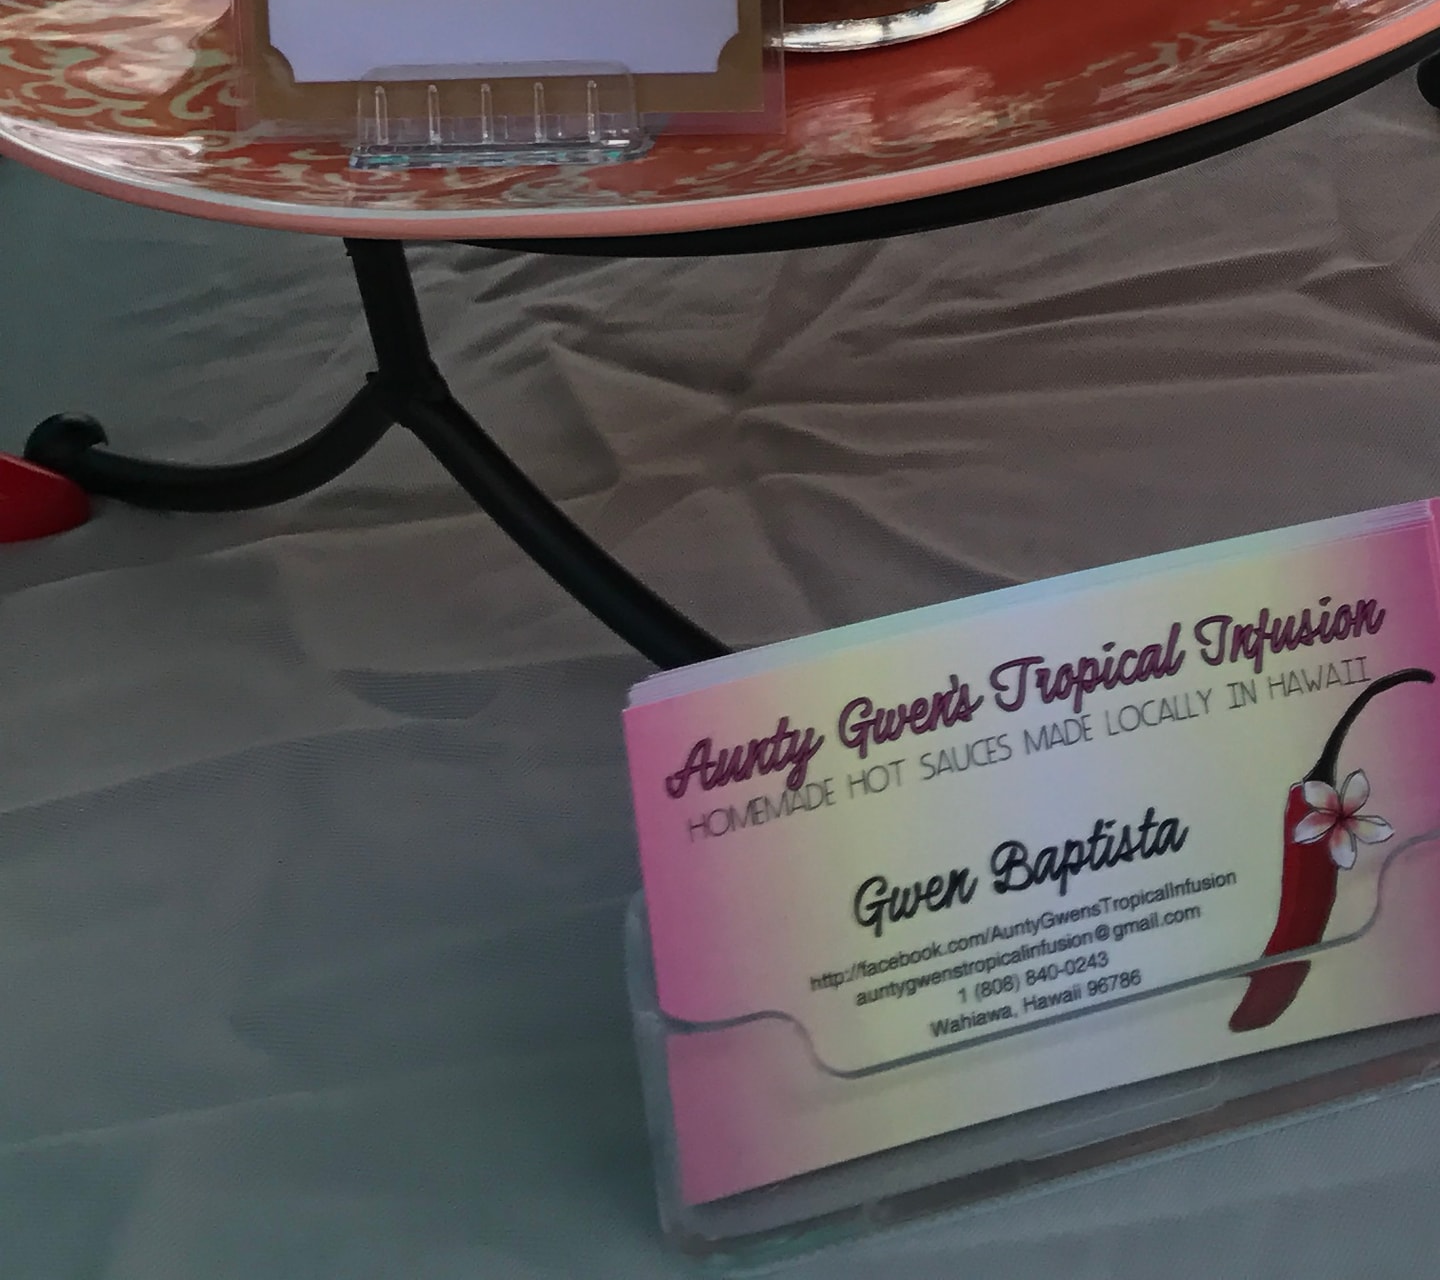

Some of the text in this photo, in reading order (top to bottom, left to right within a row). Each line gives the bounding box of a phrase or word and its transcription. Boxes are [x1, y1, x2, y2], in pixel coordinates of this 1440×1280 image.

[665, 595, 1386, 798] Aunty Gwen's Tropical Infusion
[689, 655, 1372, 842] HOMEMADE HOT SAUCES MADE LOCALLY IN HAWAII
[810, 869, 1238, 992] http://facebook.com/AuntyGwensTropicalInfusion
[853, 806, 1189, 937] Gwen Baptista
[856, 904, 1202, 1007] auntygwenstropicalinfusion@gmail.com
[929, 968, 1143, 1039] Wahiawa, Hawaii 96786
[957, 950, 1110, 1004] 1 (808) 840-0243
